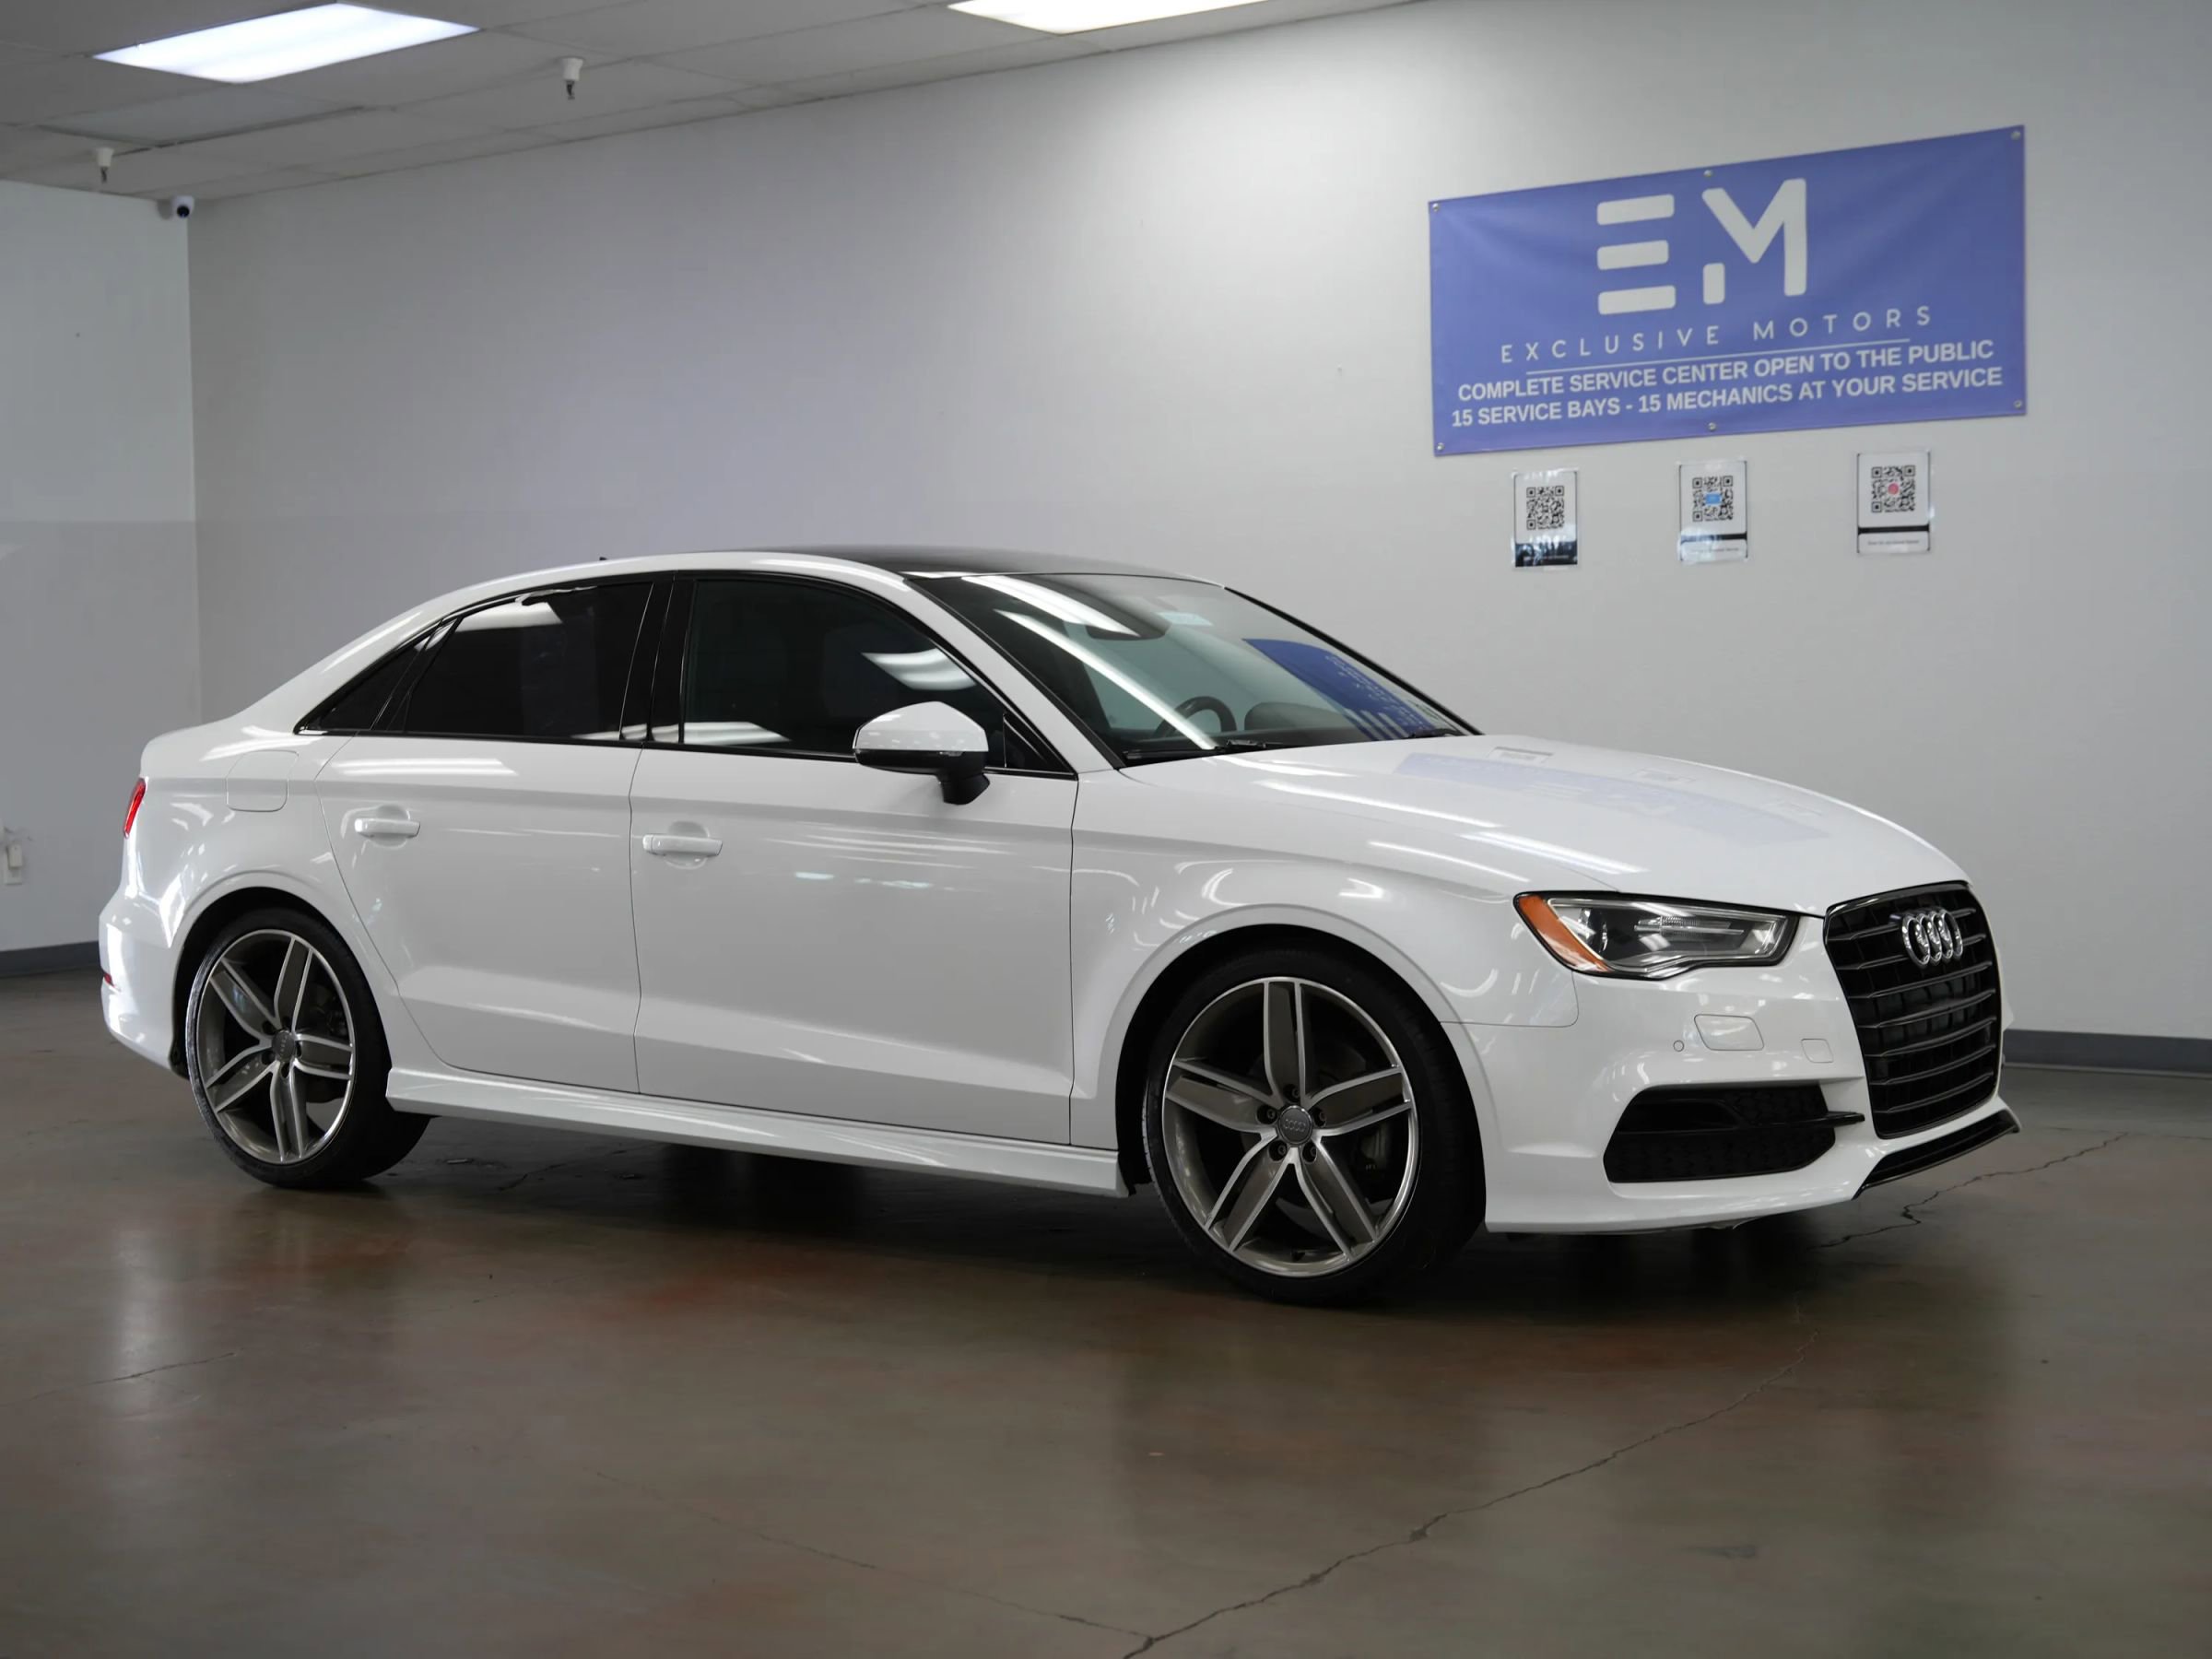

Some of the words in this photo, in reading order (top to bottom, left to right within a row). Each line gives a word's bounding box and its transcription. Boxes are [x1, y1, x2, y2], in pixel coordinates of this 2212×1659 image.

[1596, 178, 1807, 315] EM
[1500, 325, 1720, 363] EXCLUSIVE
[1753, 305, 1931, 341] MOTORS
[1452, 410, 1473, 428] 15
[1477, 402, 1562, 426] SERVICE
[1568, 397, 1620, 418] BAYS
[1638, 394, 1660, 413] 15
[1666, 383, 1793, 411] MECHANICS
[1798, 381, 1826, 401] AT
[1831, 375, 1896, 397] YOUR
[1901, 367, 2003, 394] SERVICE
[1458, 376, 1564, 401] COMPLETE
[1570, 368, 1656, 393] SERVICE
[1662, 360, 1748, 384] CENTER
[1754, 355, 1814, 378] OPEN
[1820, 351, 1850, 371] TO
[1856, 347, 1901, 369] THE
[1908, 339, 1994, 364] PUBLIC
